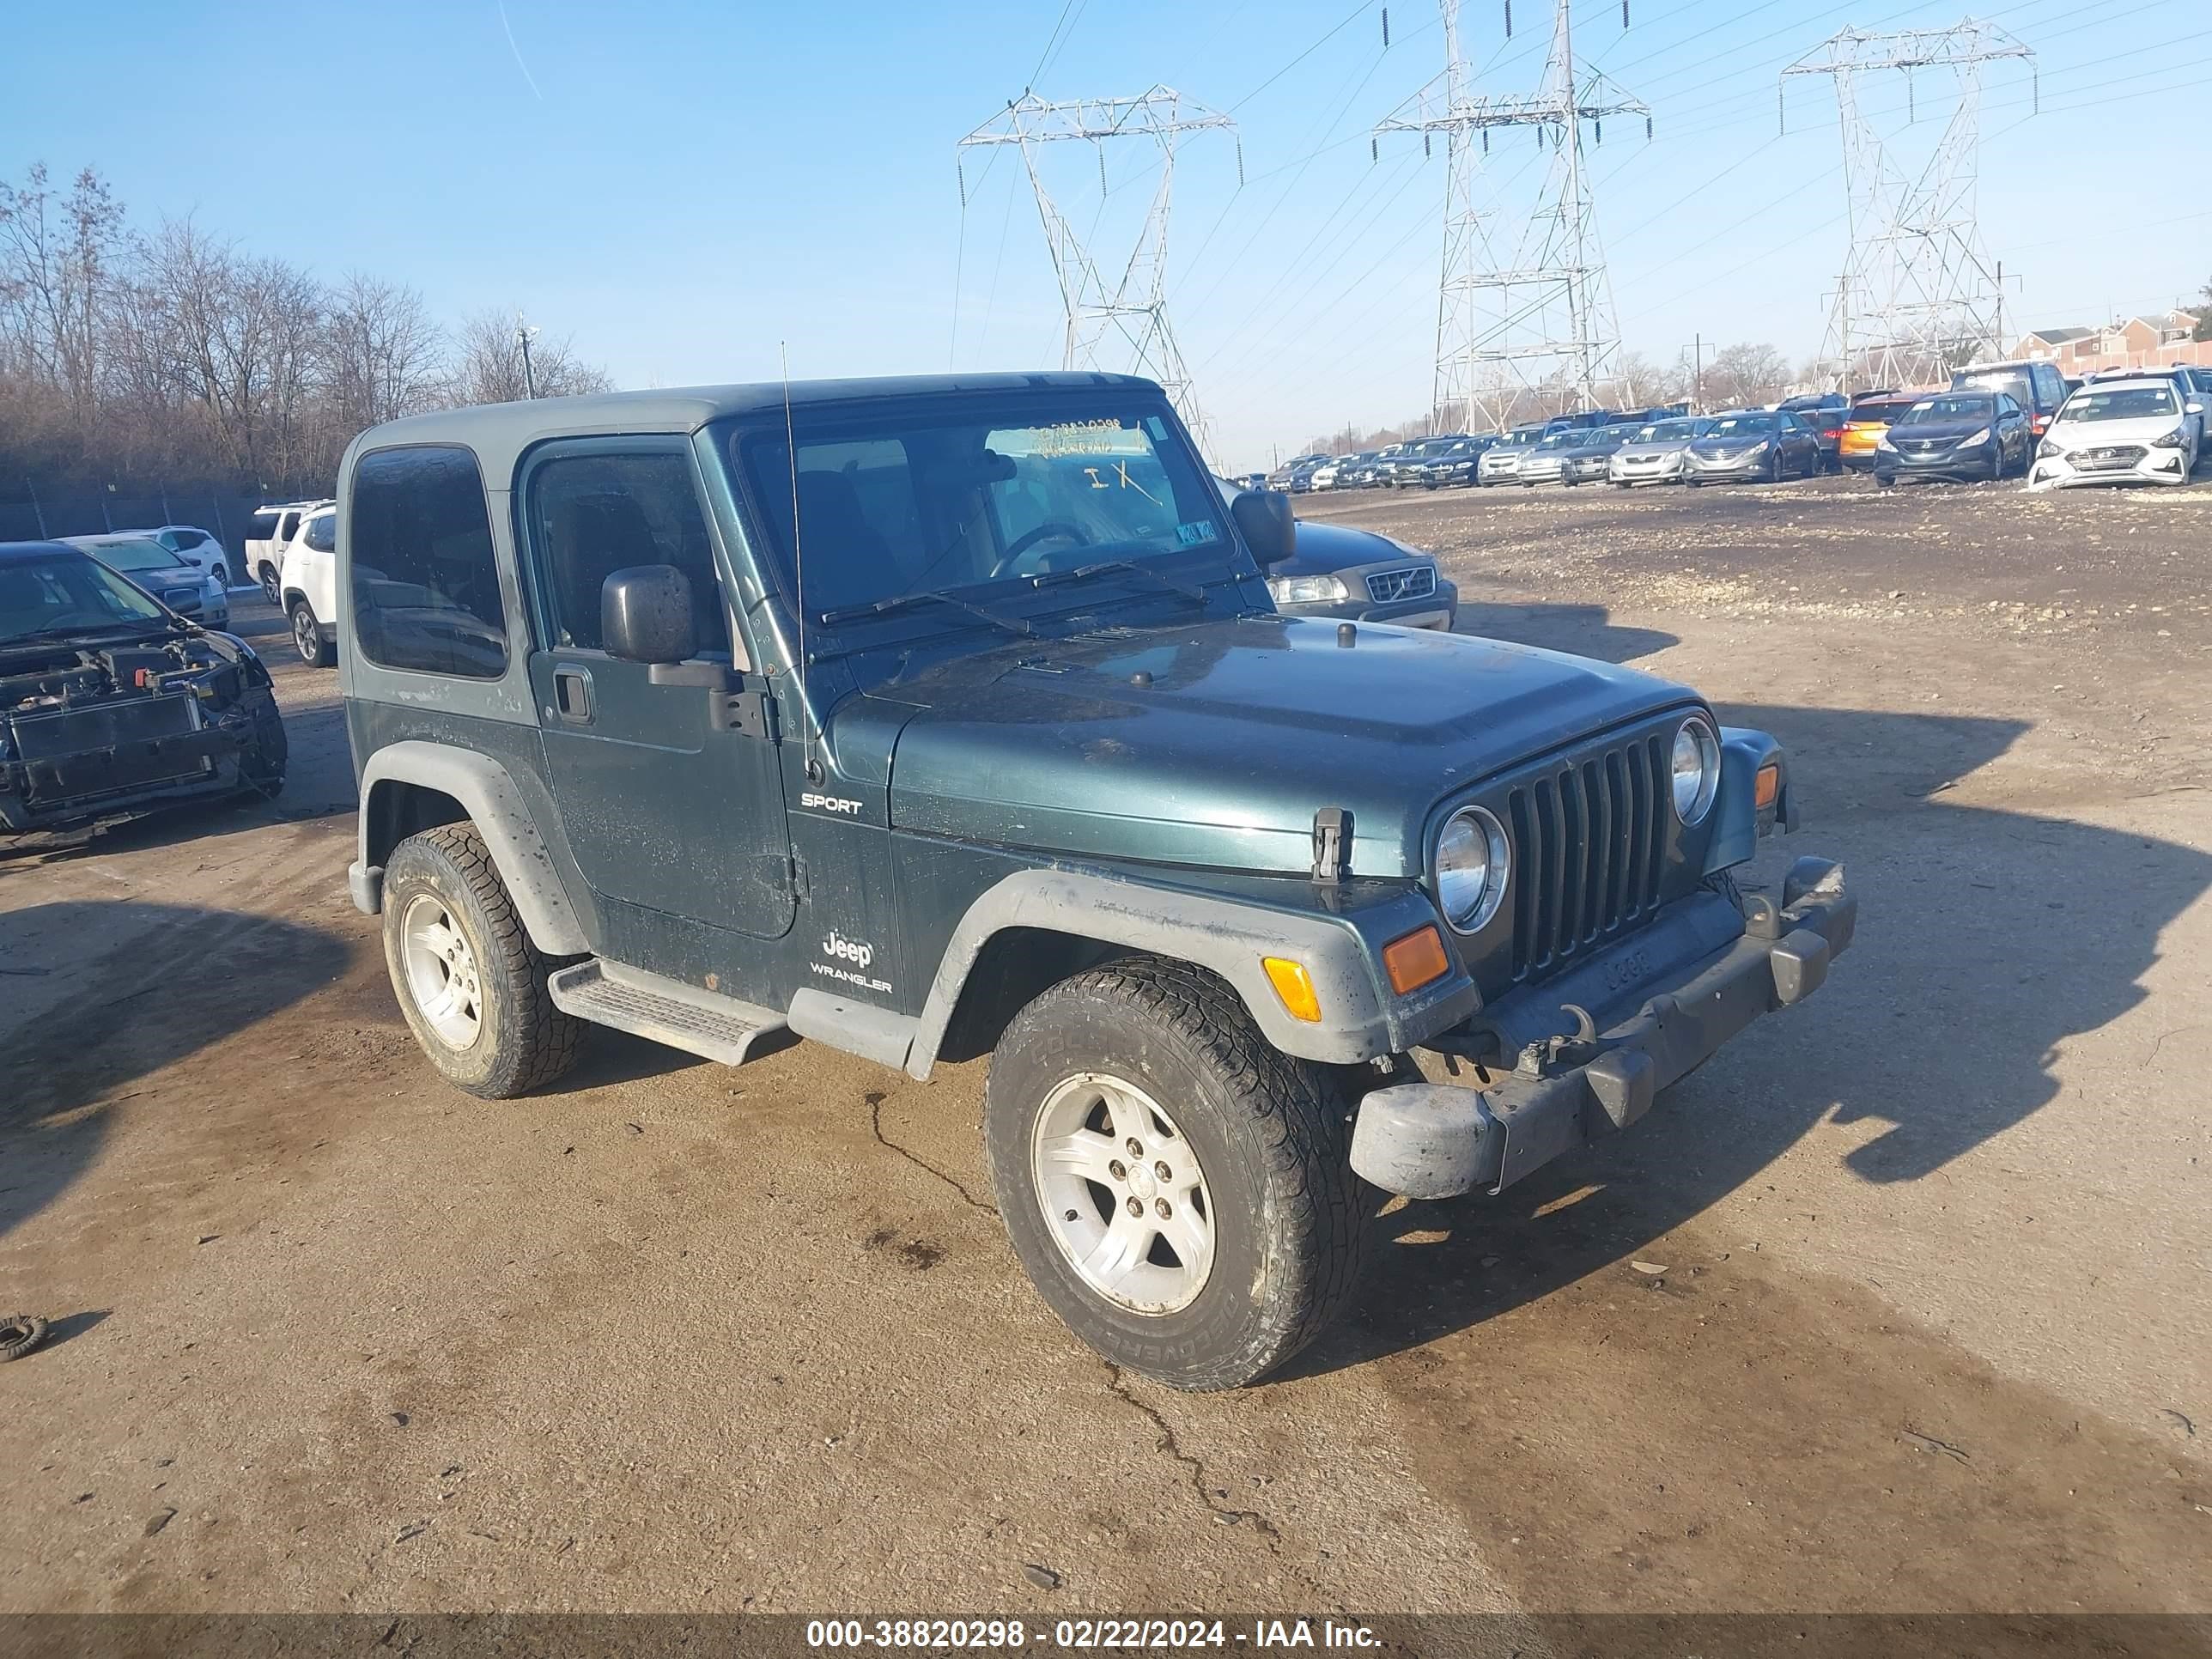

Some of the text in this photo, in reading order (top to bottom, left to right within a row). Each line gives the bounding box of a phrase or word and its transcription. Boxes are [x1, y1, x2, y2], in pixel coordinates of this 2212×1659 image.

[801, 793, 863, 815] SPORT
[823, 931, 873, 969] Jeep
[810, 961, 893, 994] WRANGLER
[1603, 951, 1650, 992] Jeep
